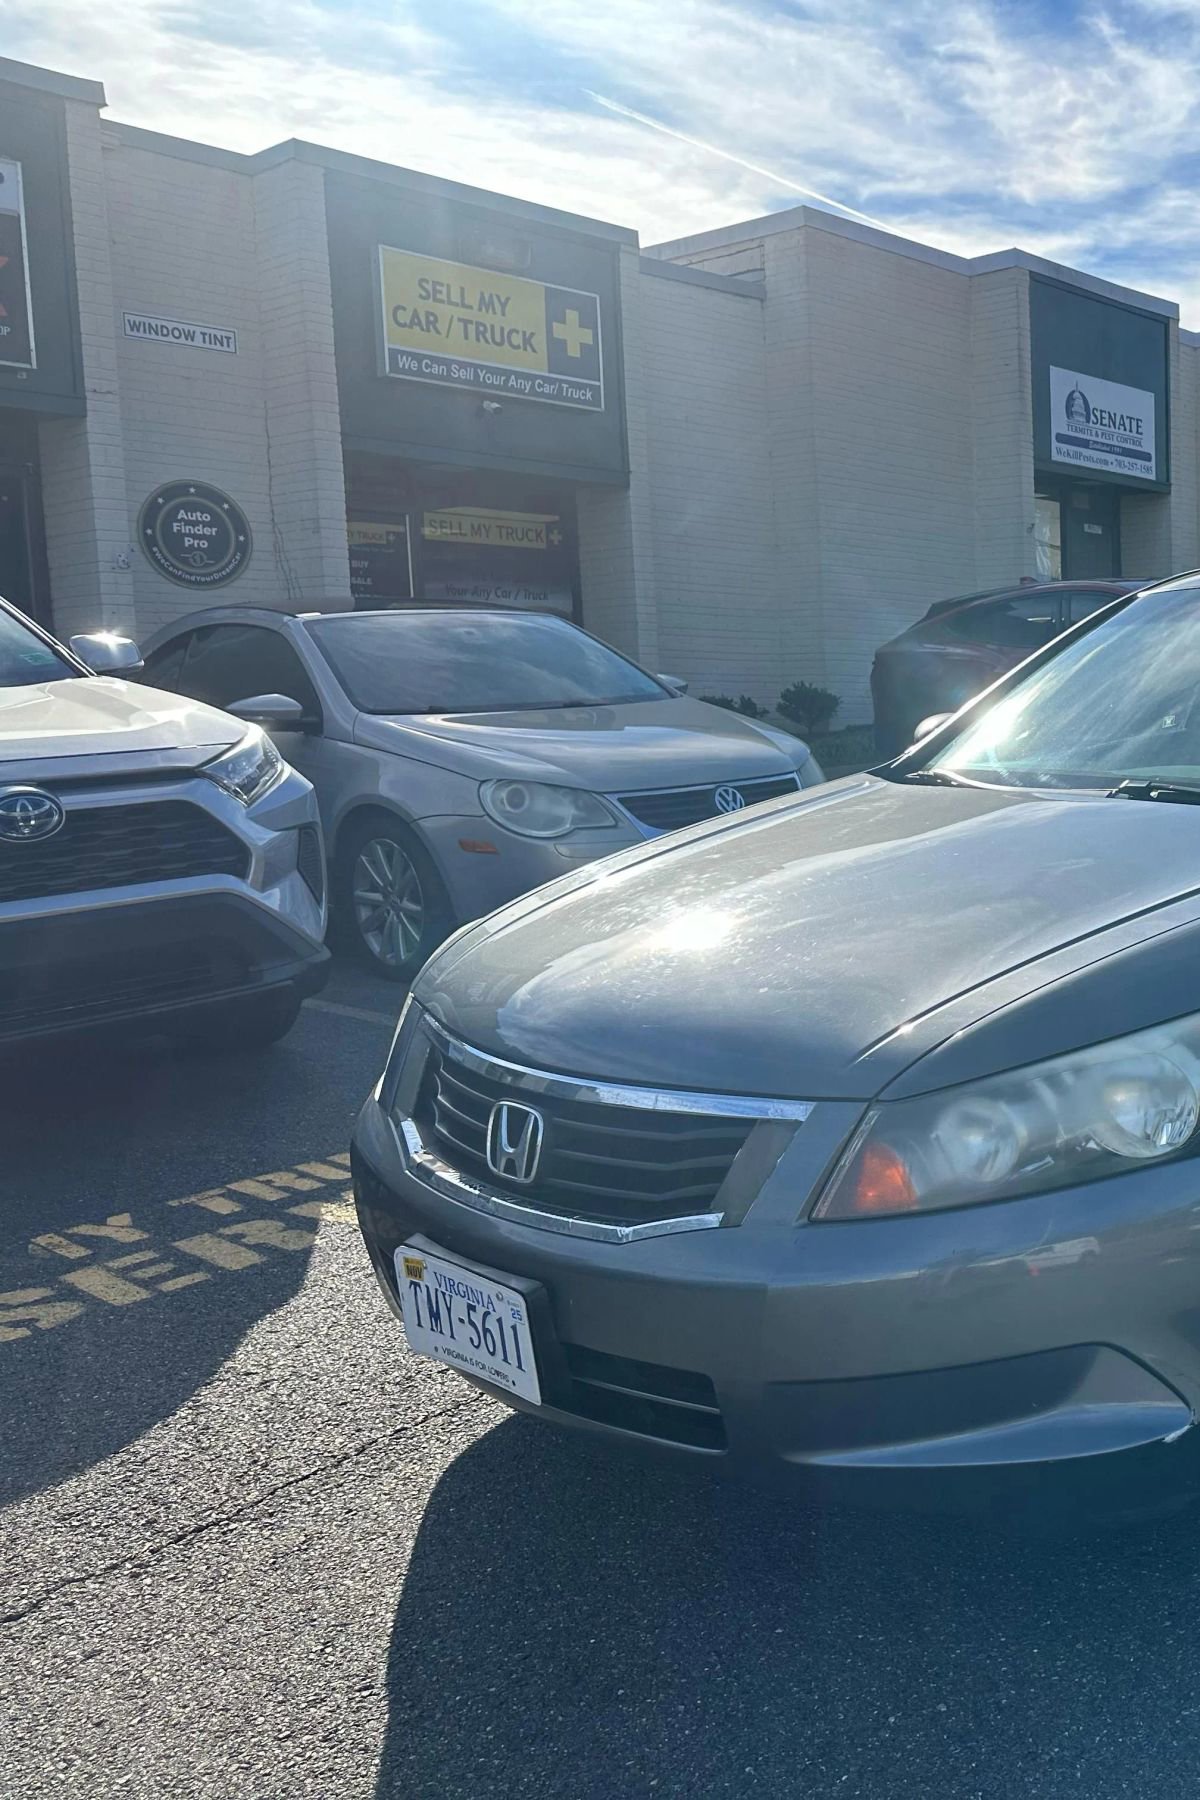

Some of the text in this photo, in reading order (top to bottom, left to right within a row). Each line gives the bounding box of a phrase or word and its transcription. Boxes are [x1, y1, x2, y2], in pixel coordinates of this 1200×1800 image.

[417, 277, 511, 317] SELL MY
[127, 319, 232, 348] WINDOW TINT
[391, 304, 442, 336] CAR
[457, 316, 538, 354] TRUCK
[397, 354, 418, 371] We
[422, 359, 447, 376] Can
[450, 364, 474, 381] Sell
[477, 369, 506, 386] Your
[508, 375, 532, 393] Any
[561, 384, 593, 401] Truck
[1066, 423, 1094, 438] TERMITE
[1100, 432, 1115, 442] PEST
[1115, 435, 1143, 448] CONTROL
[1091, 407, 1144, 436] SENATE
[1055, 446, 1153, 475] WeKillPests.com 703-257-1585
[172, 522, 218, 535] Finder
[177, 509, 211, 521] Auto
[184, 536, 208, 548] Pro
[428, 518, 545, 544] SELL MY TRUCK
[494, 586, 513, 599] Car
[405, 1264, 423, 1279] NOV
[433, 1271, 497, 1313] VIRGINIA
[408, 1280, 527, 1372] TMY-5611
[510, 1307, 523, 1321] 25
[441, 1346, 469, 1364] VIRGINIA
[469, 1358, 475, 1366] IS
[475, 1360, 487, 1372] FOR
[488, 1366, 510, 1382] LOVERS
